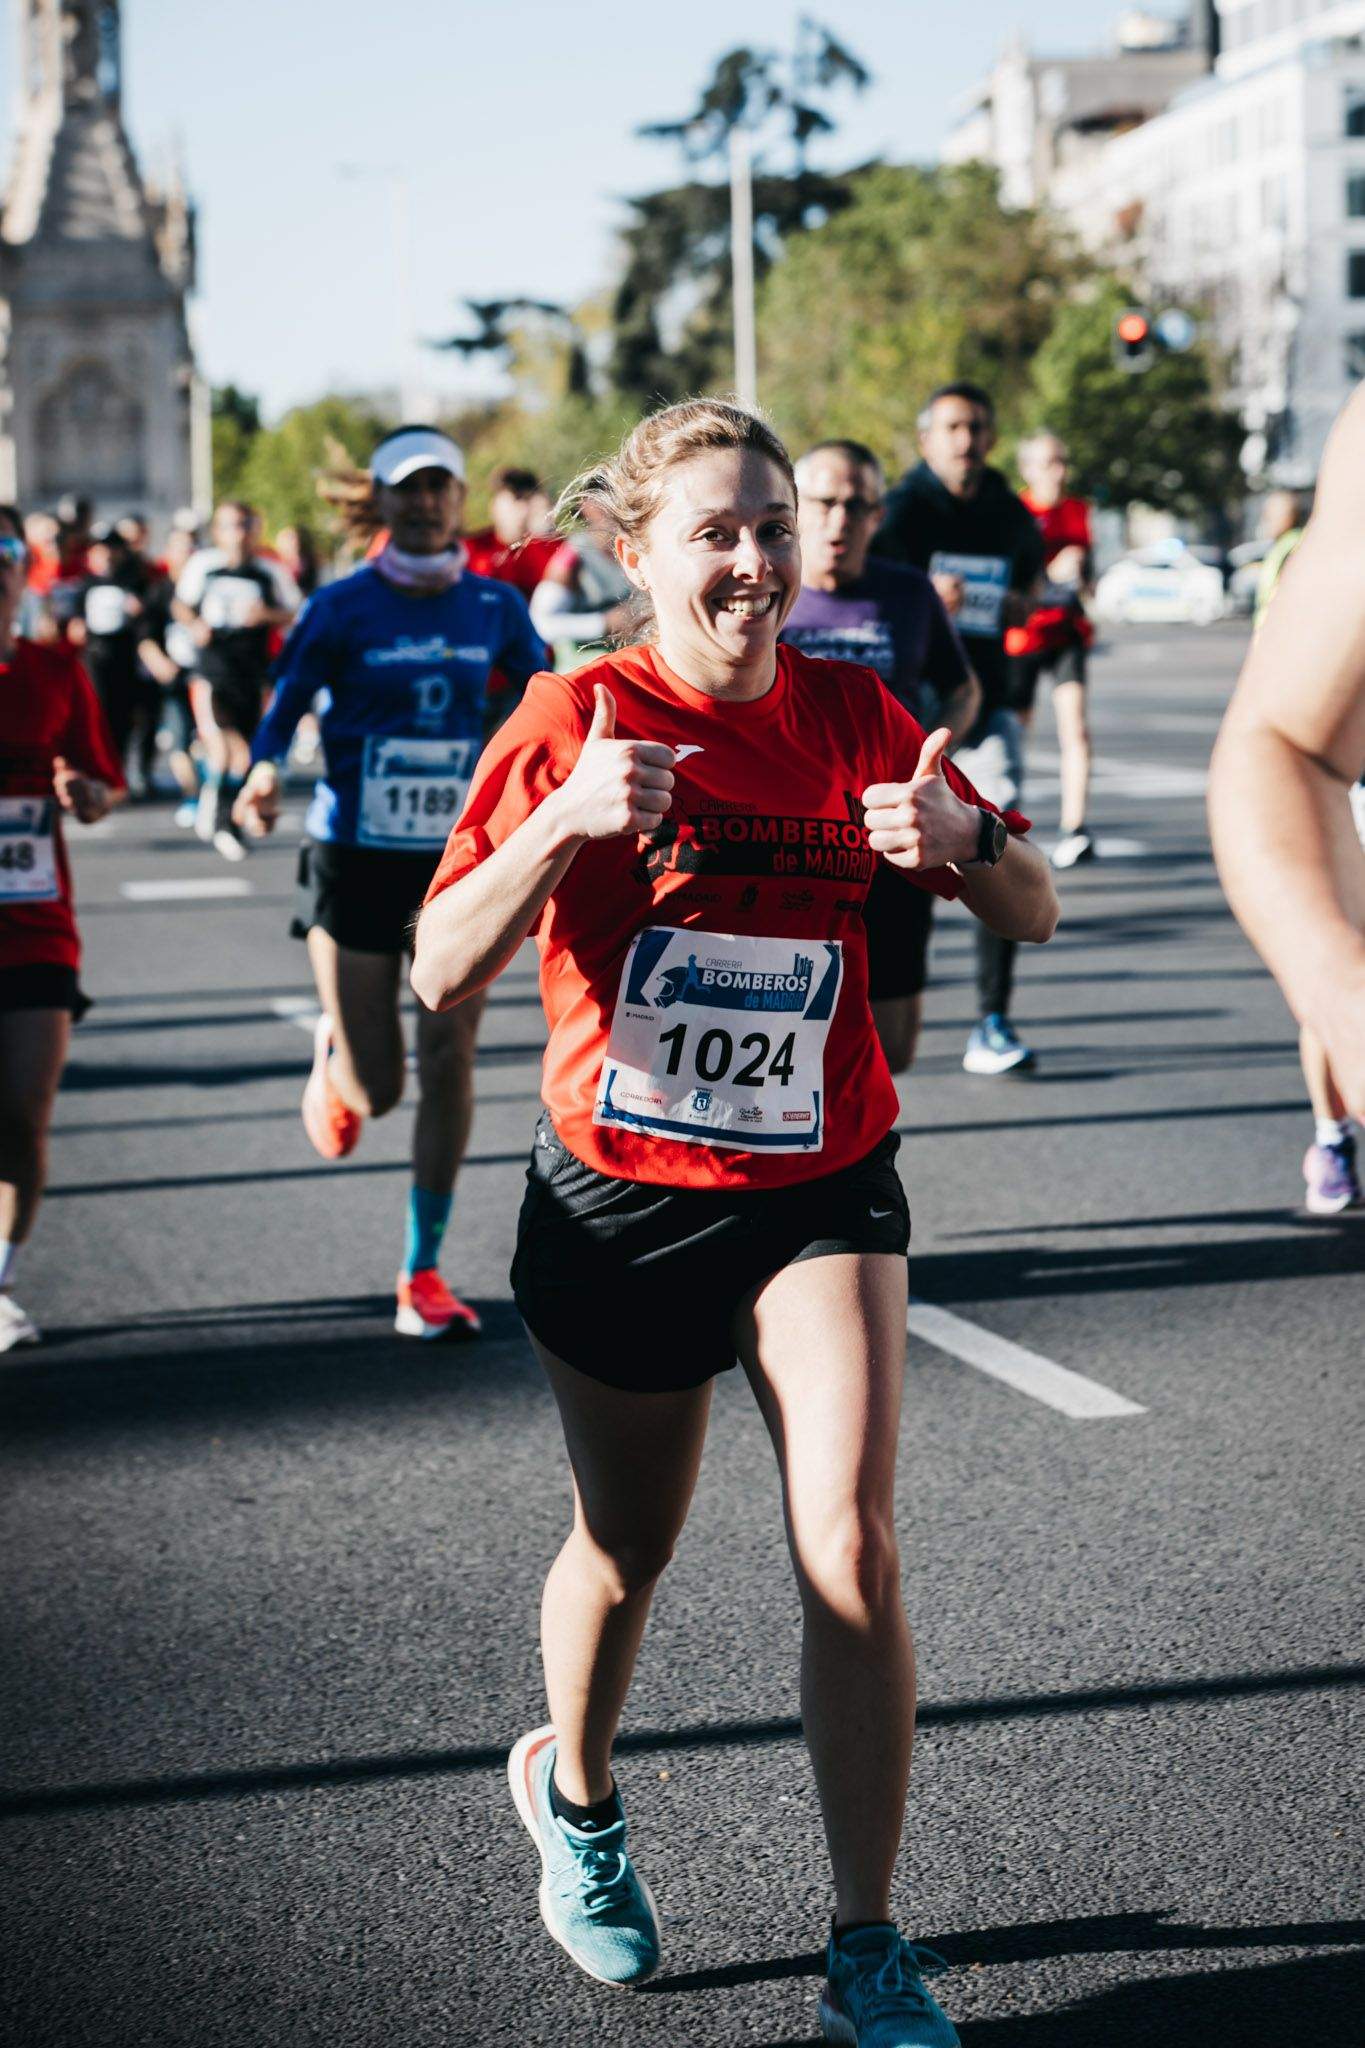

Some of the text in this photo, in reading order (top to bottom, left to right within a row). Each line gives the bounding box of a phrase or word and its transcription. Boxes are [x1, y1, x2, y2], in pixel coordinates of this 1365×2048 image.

[385, 786, 458, 815] 1189
[772, 849, 871, 880] de MADRID
[705, 957, 743, 969] CARRERA
[702, 970, 809, 992] BOMBEROS
[744, 991, 805, 1010] de MADRID
[659, 1023, 796, 1087] 1024
